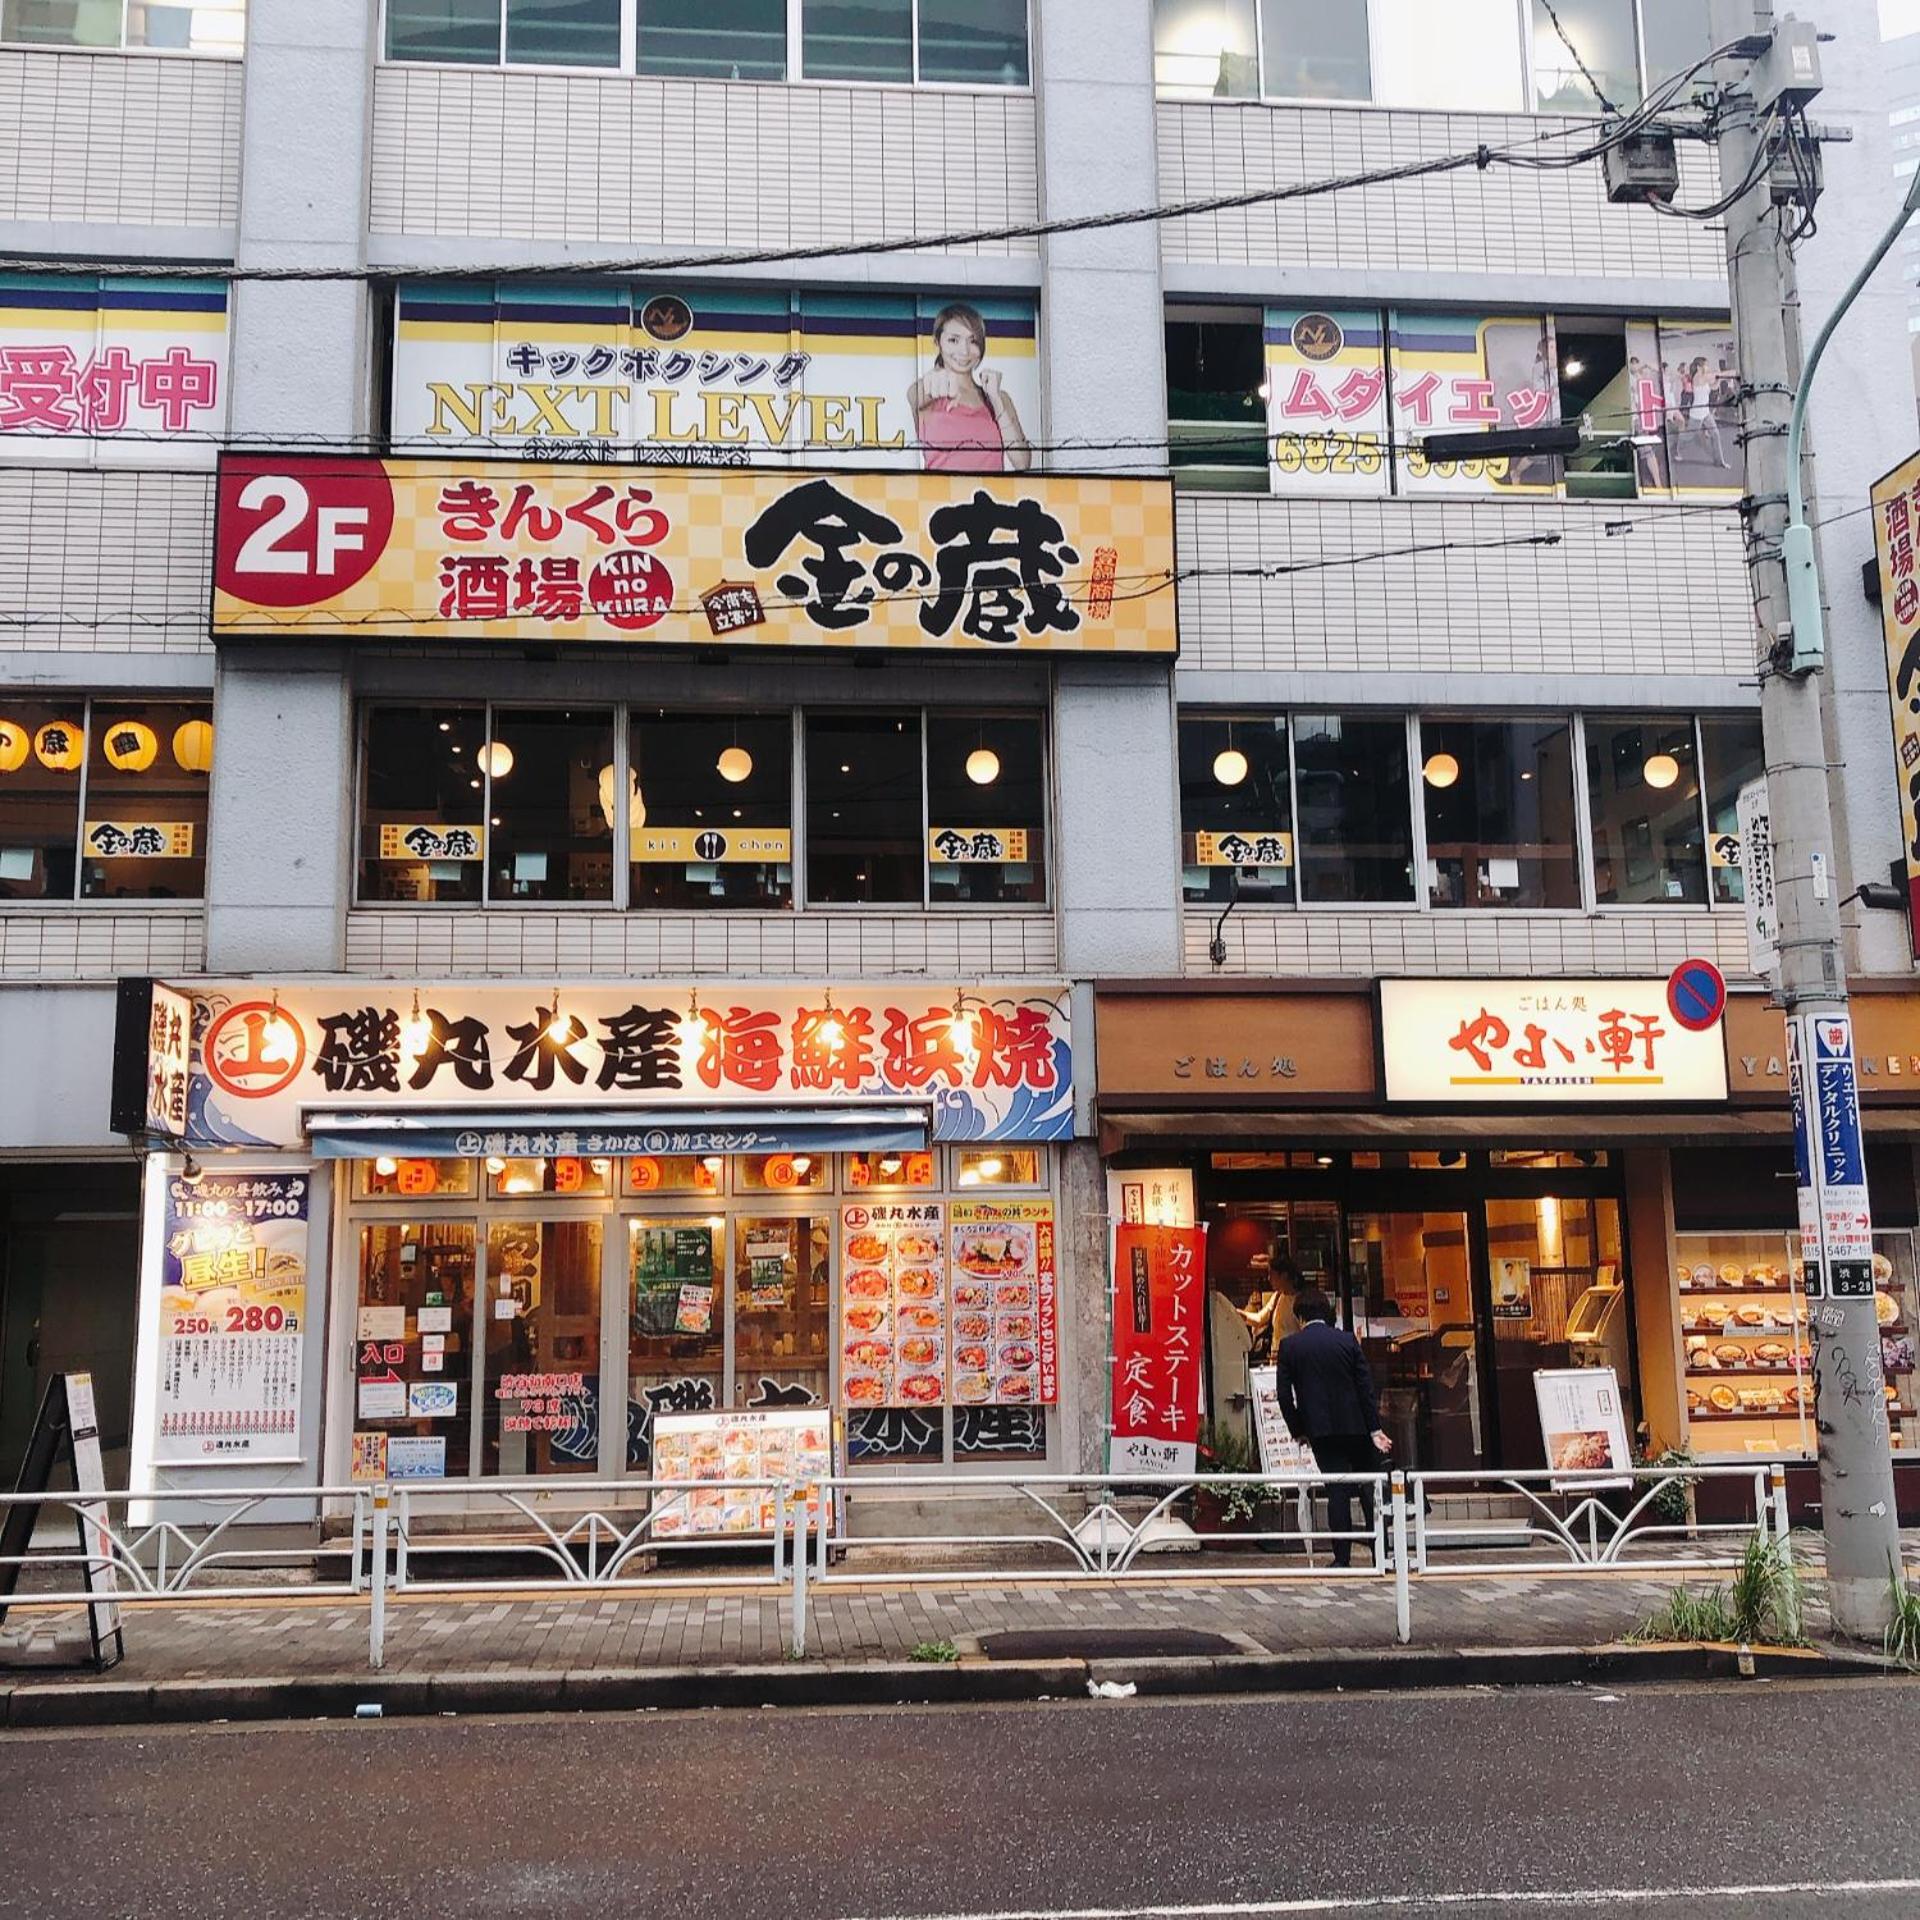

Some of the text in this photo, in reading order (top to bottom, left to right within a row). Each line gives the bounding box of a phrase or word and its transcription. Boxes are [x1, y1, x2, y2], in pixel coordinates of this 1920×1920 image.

[0, 345, 217, 432] 受付中
[508, 344, 810, 388] キックボクシング
[426, 383, 905, 448] NEXT LEVEL
[235, 476, 369, 576] 2F
[437, 481, 669, 546] きんくら
[439, 555, 587, 621] 酒場
[601, 553, 651, 576] KIN
[613, 578, 648, 594] no
[744, 479, 1081, 643] 金の蔵
[597, 596, 669, 618] KURA
[1519, 996, 1588, 1012] ごはん処
[1174, 1056, 1298, 1079] ごはん処
[1449, 1008, 1665, 1072] やよい軒
[1820, 1064, 1847, 1184] デンタルクリニック
[1842, 1067, 1856, 1126] ウエスト
[587, 1135, 641, 1151] さかな
[672, 1135, 777, 1150] 加工センター
[872, 1206, 940, 1220] 磯丸水産
[360, 1343, 404, 1364] 入口
[1160, 1242, 1194, 1432] カットステーキ
[1121, 1351, 1155, 1428] 定食
[1126, 1443, 1179, 1462] やよい軒
